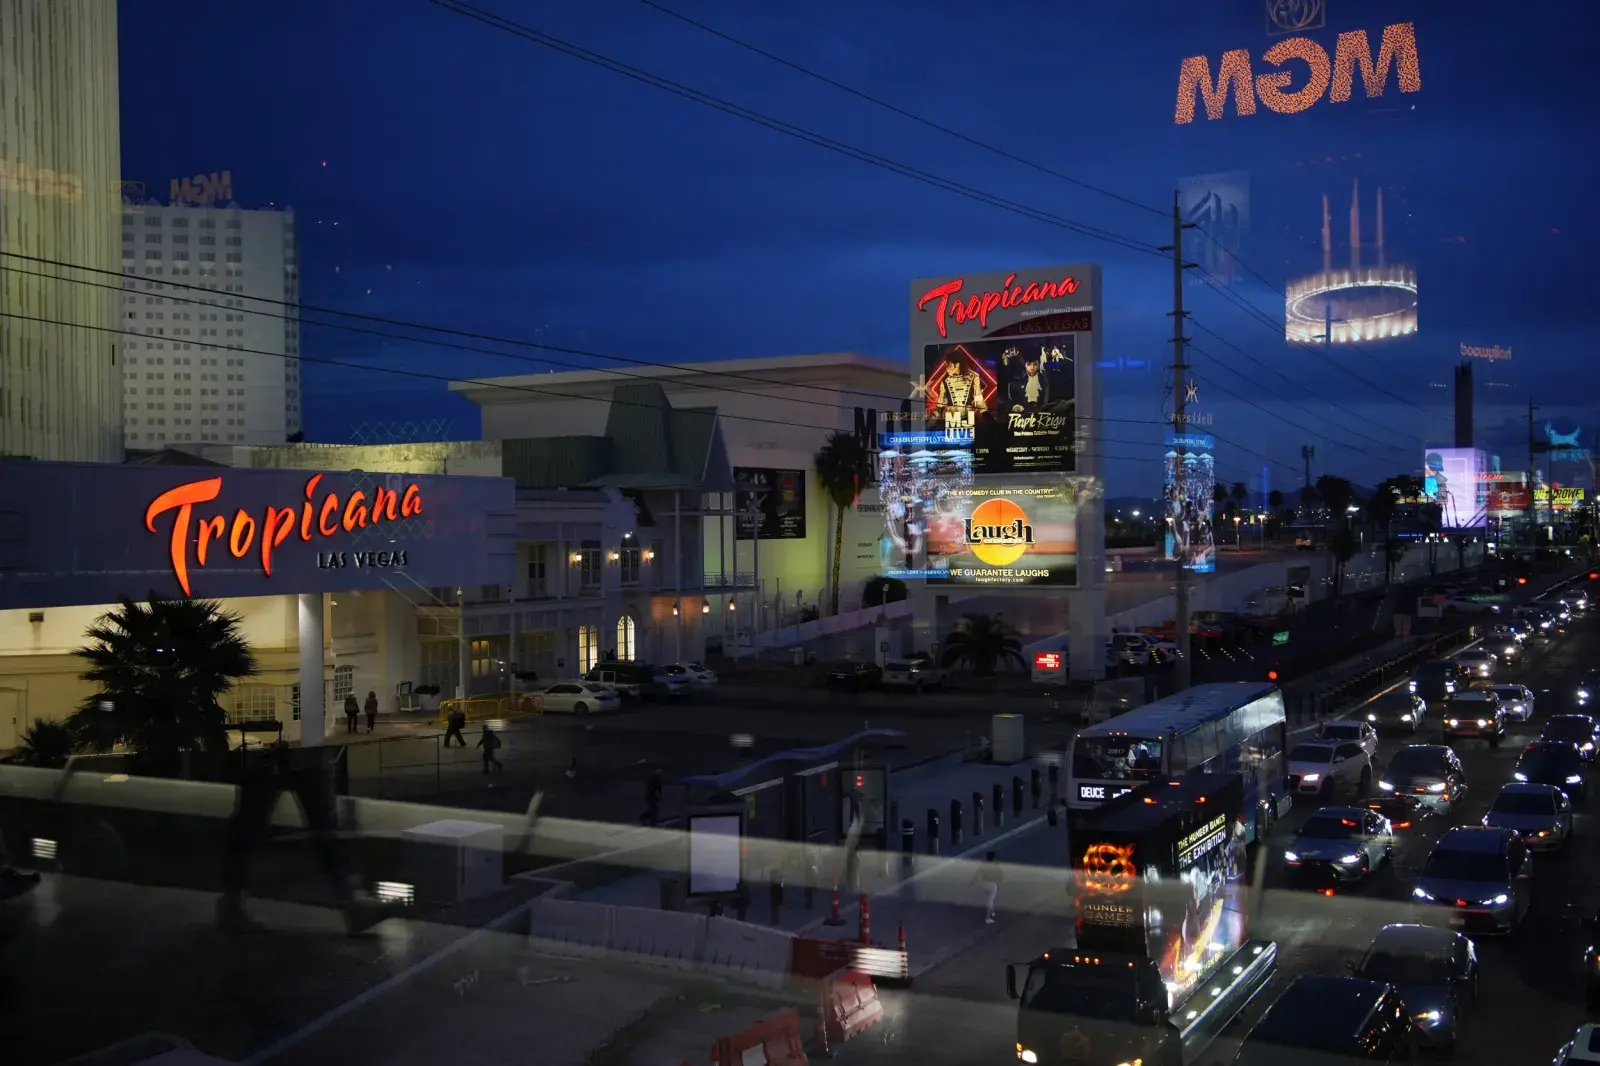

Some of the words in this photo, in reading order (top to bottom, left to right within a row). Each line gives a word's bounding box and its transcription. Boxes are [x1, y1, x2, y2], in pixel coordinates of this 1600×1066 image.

[918, 273, 1080, 339] Tropicana
[1019, 322, 1042, 333] LAS
[1046, 318, 1088, 331] VEGAS
[945, 411, 975, 428] MJ
[1008, 413, 1037, 431] Purple
[1037, 412, 1066, 428] Reign
[945, 428, 975, 441] LIVE
[144, 472, 423, 598] Tropicana
[963, 518, 1035, 545] Laugh
[316, 552, 347, 570] LAS
[353, 549, 408, 569] VEGAS
[965, 569, 1013, 577] GUARANTEE
[1015, 569, 1050, 577] LAUGHS
[1081, 786, 1105, 798] DEUCE
[1178, 835, 1189, 850] THE
[1189, 823, 1209, 844] HUNGER
[1209, 813, 1226, 832] GAMES
[1179, 853, 1193, 869] THE
[1193, 829, 1227, 860] EXHIBITION
[1084, 904, 1134, 913] HUNGER
[1085, 911, 1136, 922] GAMES
